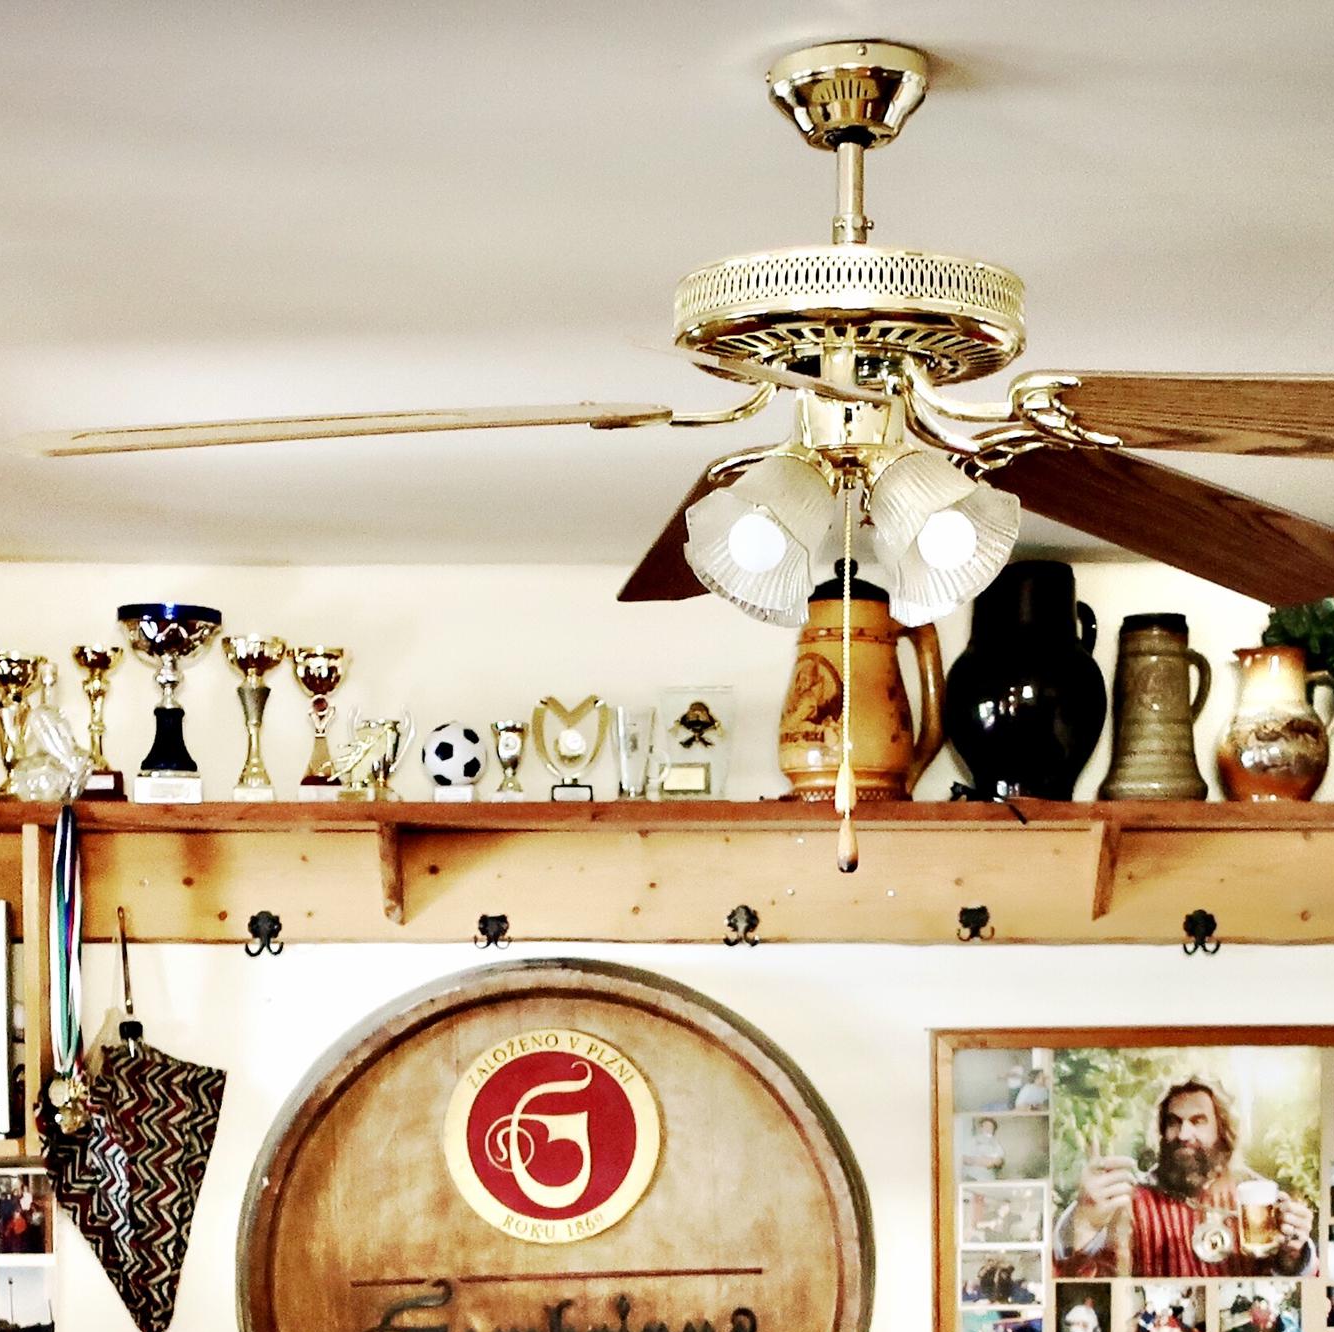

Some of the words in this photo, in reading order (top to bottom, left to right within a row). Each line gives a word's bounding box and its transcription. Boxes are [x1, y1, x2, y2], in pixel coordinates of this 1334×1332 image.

[466, 1033, 559, 1089] ZALOŽENO
[569, 1036, 581, 1049] V
[586, 1042, 636, 1085] PLZNI
[502, 1214, 557, 1239] ROKU
